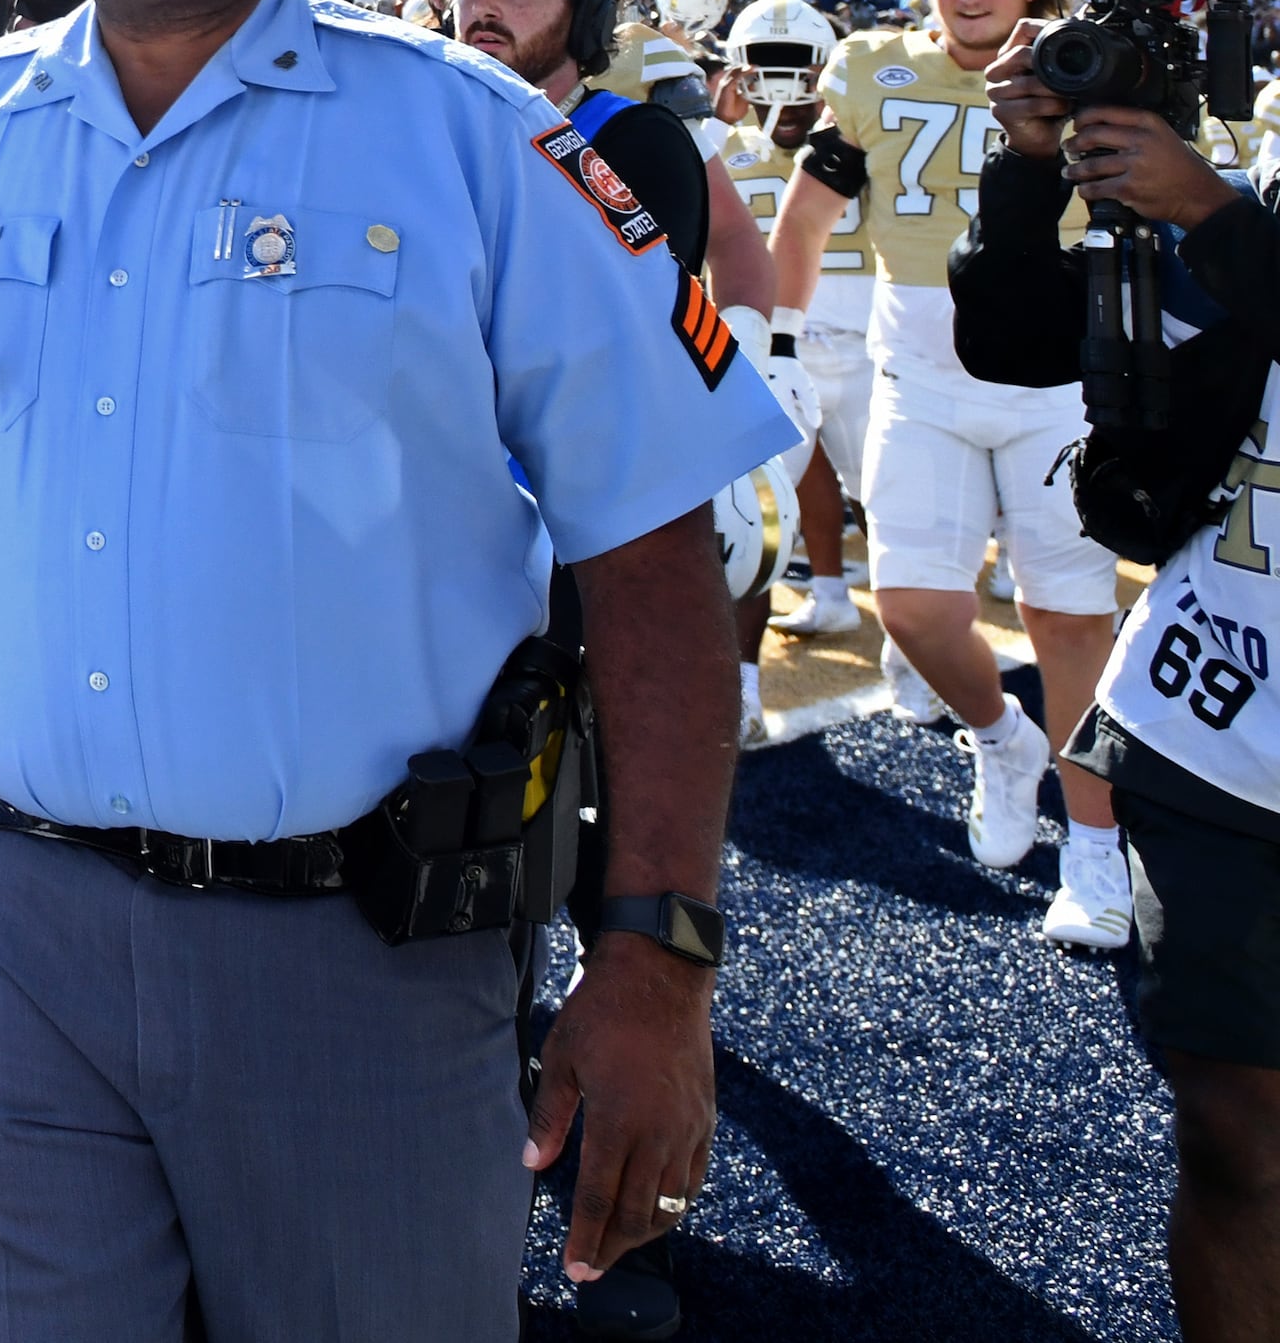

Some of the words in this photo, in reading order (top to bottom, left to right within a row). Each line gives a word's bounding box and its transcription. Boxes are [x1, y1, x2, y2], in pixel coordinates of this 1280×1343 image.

[545, 129, 587, 159] GEORGIA
[880, 98, 998, 216] 75
[1149, 622, 1256, 731] 69
